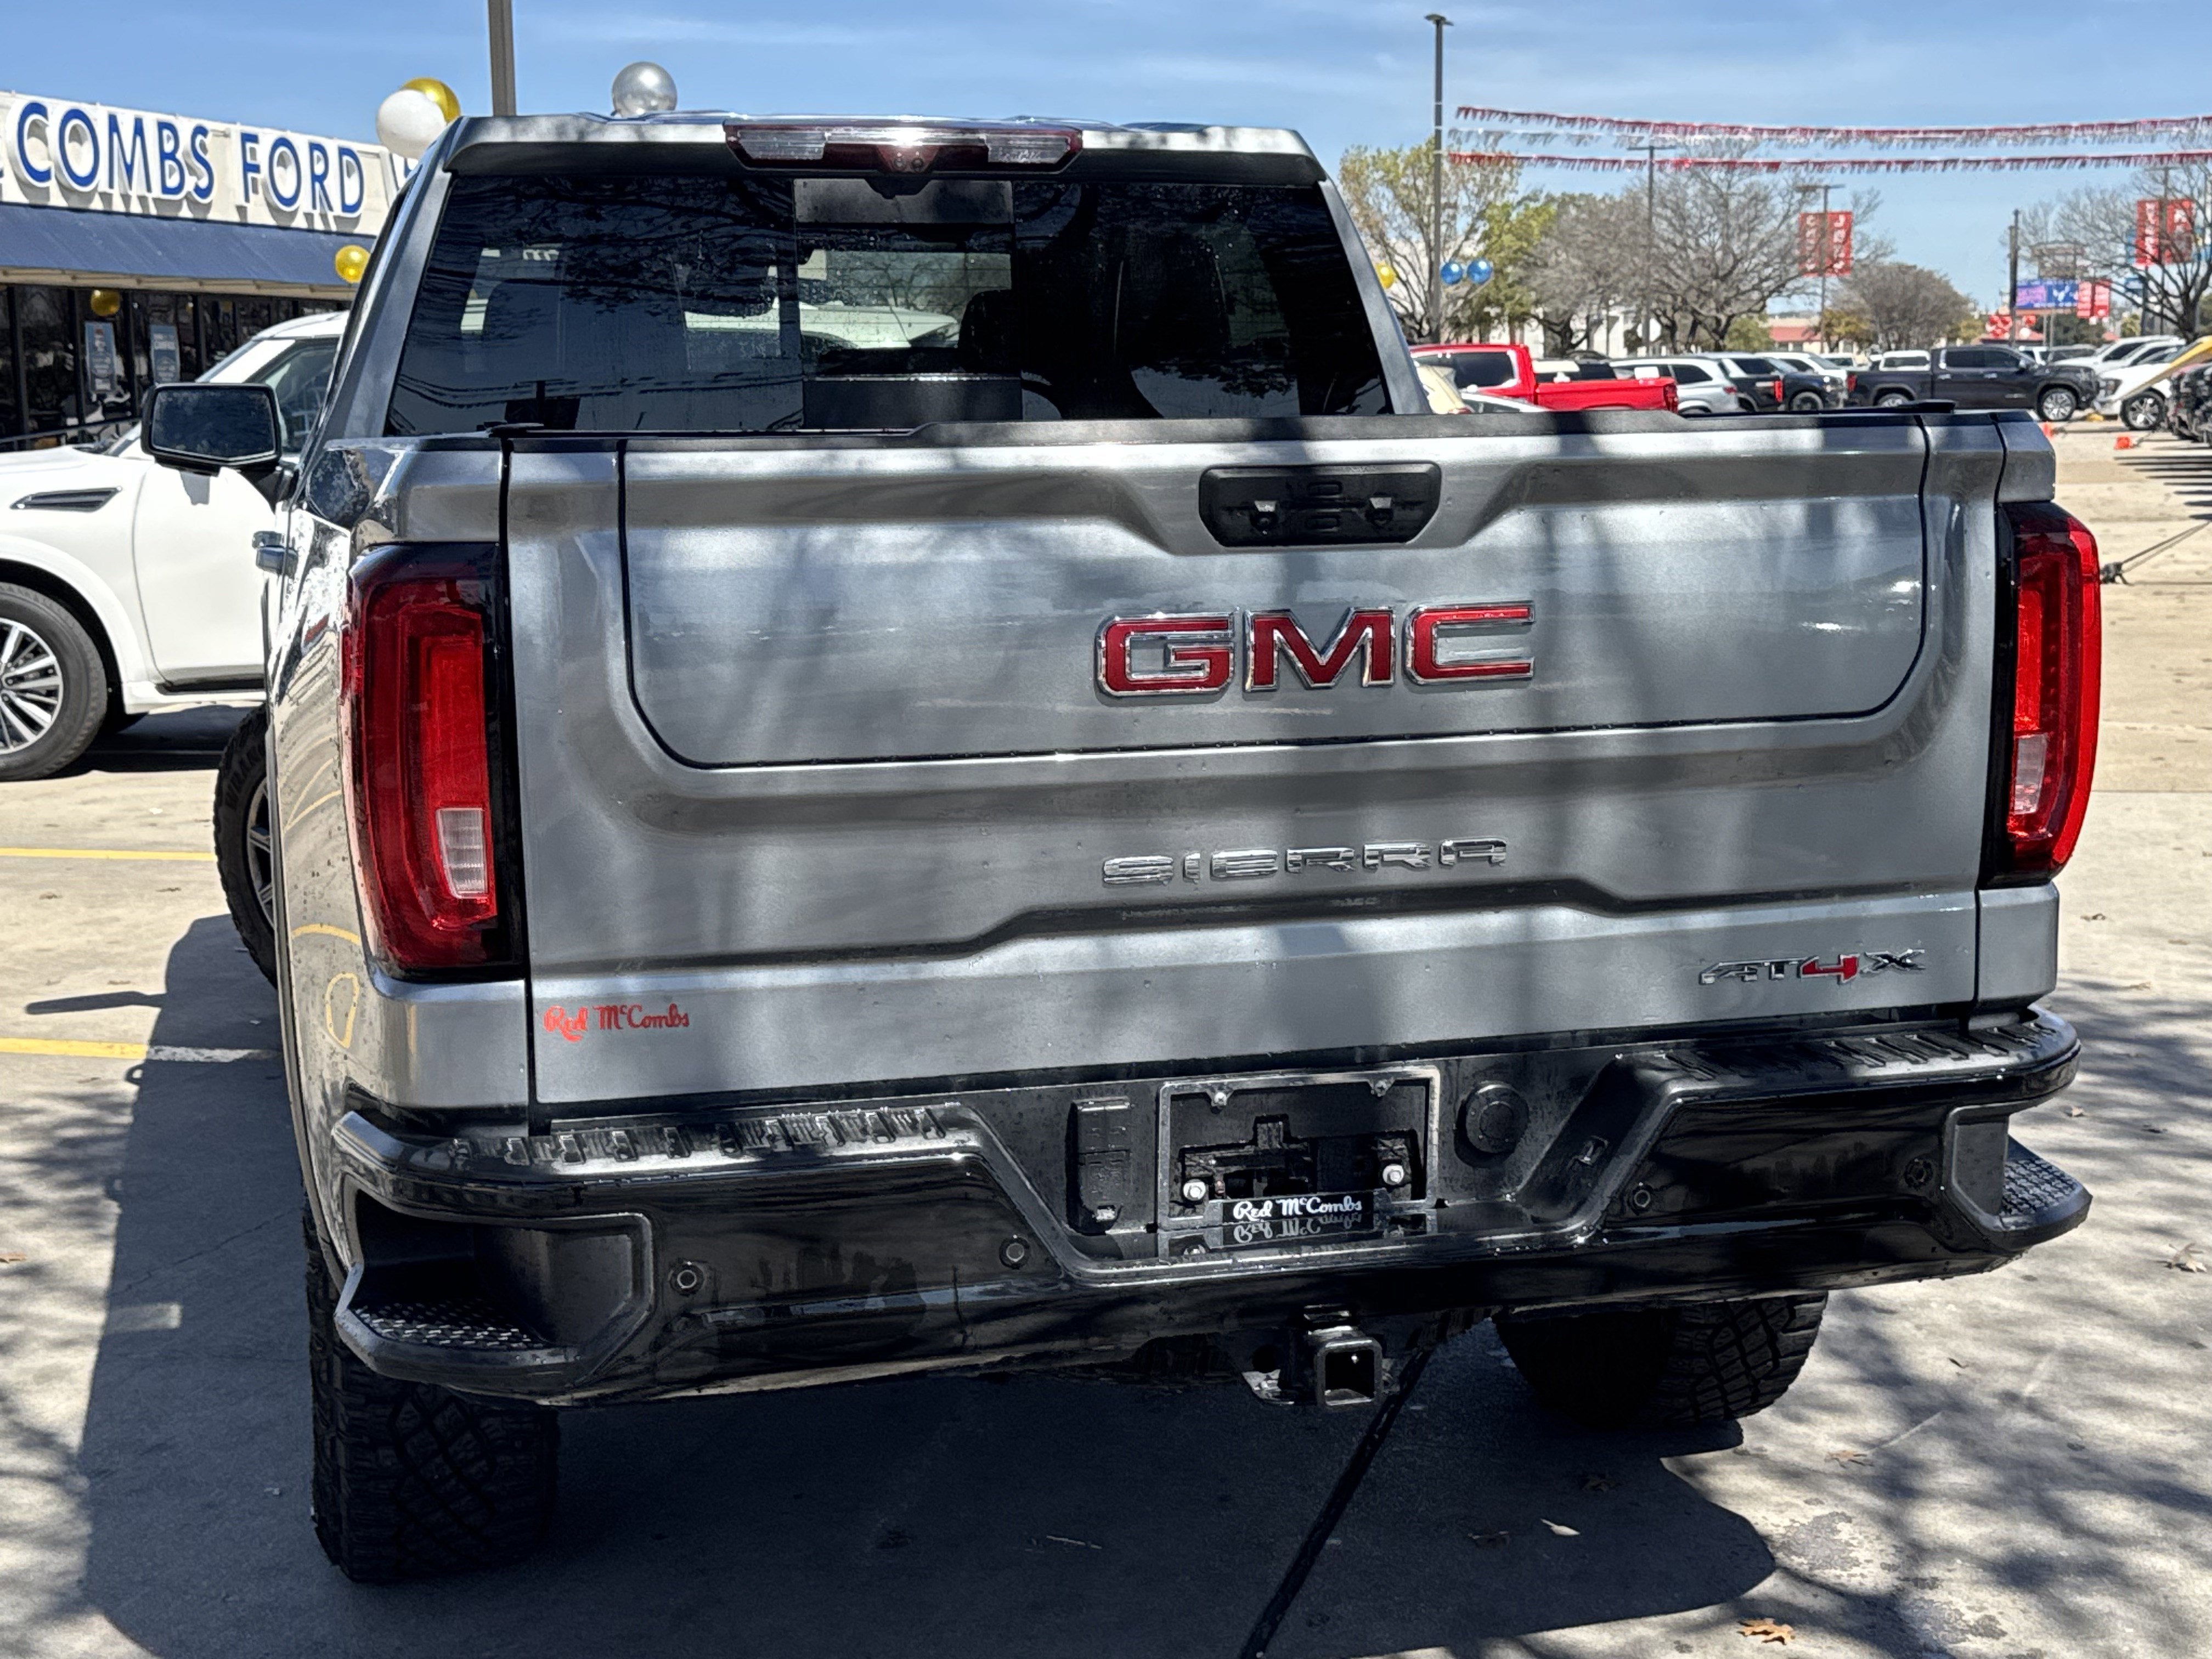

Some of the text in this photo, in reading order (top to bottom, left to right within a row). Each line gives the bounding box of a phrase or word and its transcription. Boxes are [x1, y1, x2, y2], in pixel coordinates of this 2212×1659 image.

[17, 101, 215, 200] COMBS
[240, 132, 365, 215] FORD
[1096, 601, 1534, 697] GMC
[1102, 838, 1508, 885] SIERRA
[1700, 949, 1926, 985] AT4X
[543, 1003, 690, 1043] Red McCombs
[1233, 1195, 1362, 1222] Red McCombs
